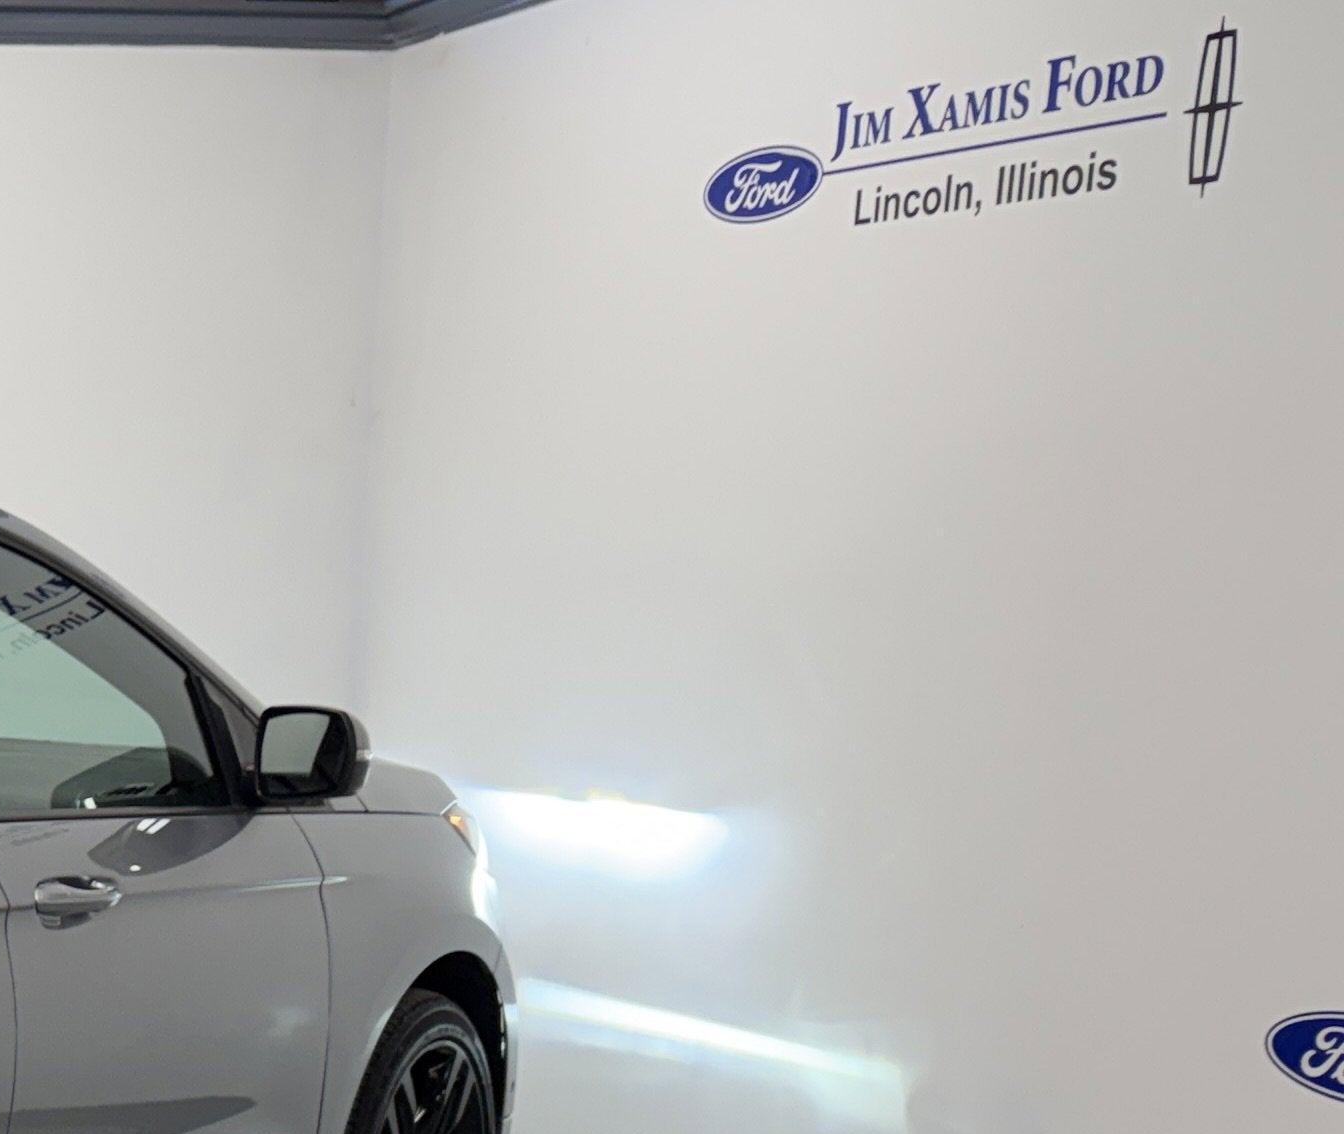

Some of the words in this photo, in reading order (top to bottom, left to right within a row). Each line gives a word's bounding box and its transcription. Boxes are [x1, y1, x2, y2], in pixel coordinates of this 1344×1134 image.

[831, 101, 892, 161] JIM
[903, 82, 1030, 139] XAMIS
[1042, 54, 1164, 114] FORD
[725, 160, 796, 212] Ford
[854, 175, 981, 226] Lincoln,
[996, 152, 1117, 205] Illinois
